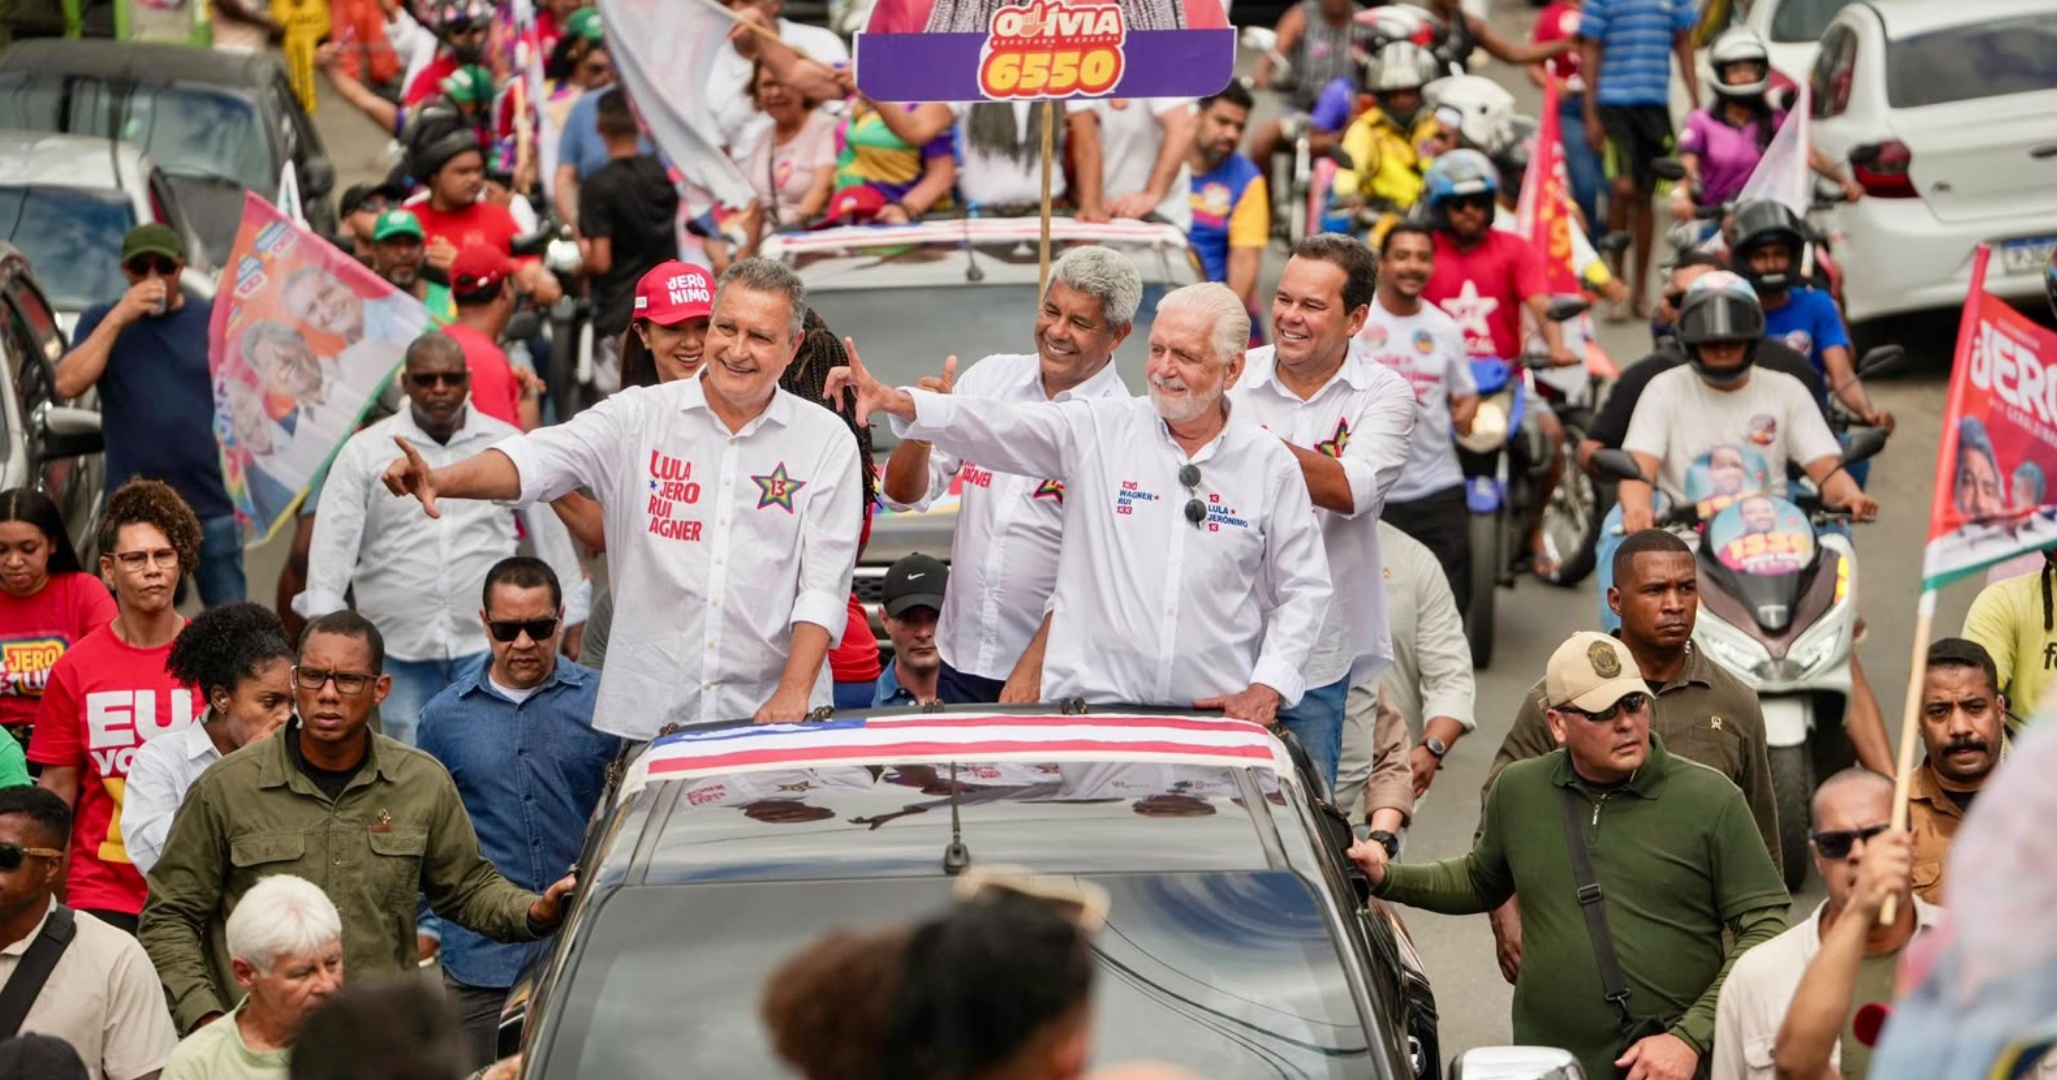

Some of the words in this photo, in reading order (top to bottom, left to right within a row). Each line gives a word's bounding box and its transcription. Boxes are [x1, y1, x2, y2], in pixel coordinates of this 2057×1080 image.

[987, 49, 1116, 90] 6550
[669, 288, 710, 305] NIMO
[650, 449, 691, 481] LULA
[659, 481, 700, 504] JERO
[770, 480, 787, 497] 13
[1119, 489, 1154, 501] WAGNER
[647, 494, 672, 518] RUI
[1117, 497, 1132, 505] RUI
[1209, 494, 1220, 503] 13
[1116, 505, 1133, 515] 133
[1208, 504, 1229, 515] LULA
[649, 516, 703, 541] AGNER
[1208, 523, 1219, 532] 13
[8, 648, 58, 673] JERO
[86, 689, 193, 749] EU
